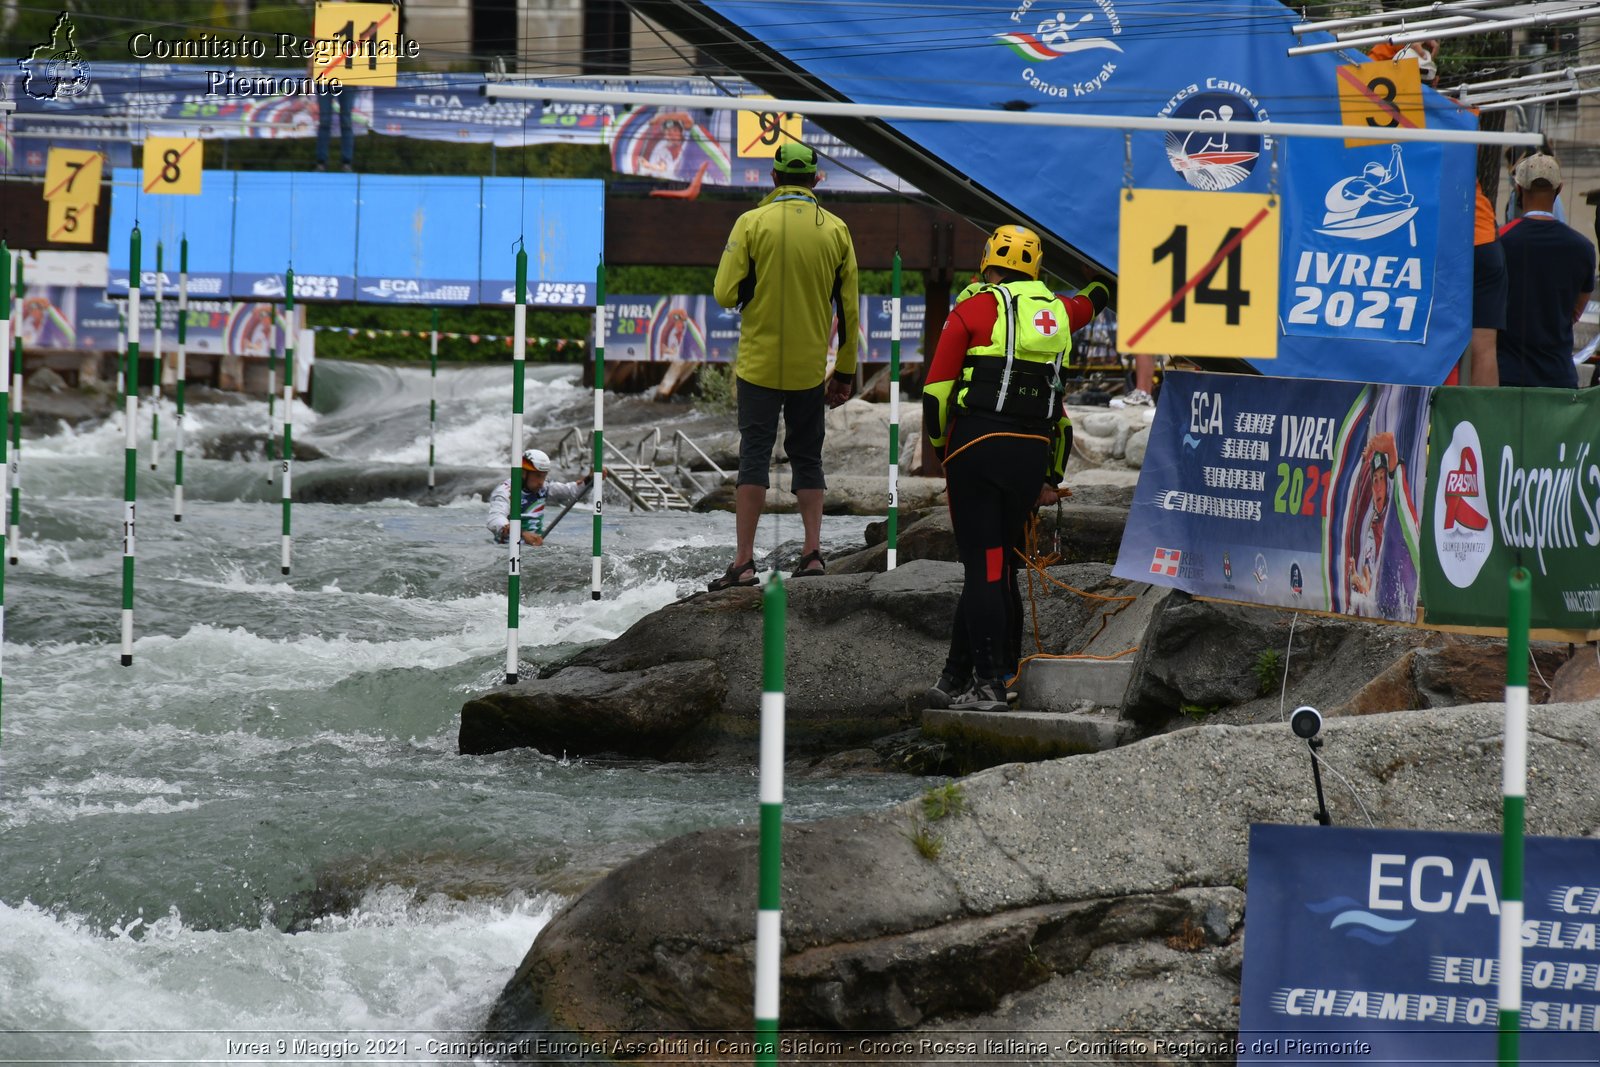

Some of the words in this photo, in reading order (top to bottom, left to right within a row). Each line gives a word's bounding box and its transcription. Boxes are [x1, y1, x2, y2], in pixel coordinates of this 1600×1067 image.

[336, 20, 380, 71] 11
[1021, 66, 1069, 98] Canoa
[1073, 60, 1117, 97] Kayak
[1206, 77, 1260, 108] Canoa
[1366, 77, 1401, 128] 3
[759, 111, 781, 145] 9
[65, 162, 82, 193] 7
[162, 149, 181, 183] 8
[64, 207, 78, 232] 5
[140, 272, 170, 285] CA
[380, 281, 419, 292] ECA
[1152, 225, 1250, 326] 14
[1295, 251, 1422, 290] IVREA
[535, 294, 586, 304] 2021
[538, 284, 586, 294] IVREA
[618, 304, 653, 318] IVREA
[1288, 286, 1418, 331] 2021
[617, 318, 653, 334] 2021
[1190, 391, 1224, 435] ECA
[1234, 412, 1277, 435] CANOE
[1220, 437, 1270, 461] SLALOM
[1279, 415, 1336, 460] IVREA
[1203, 466, 1266, 491] EUROPEAN
[1274, 462, 1332, 518] 2021
[596, 501, 602, 513] 9
[1155, 489, 1262, 522] CHAMPIONSHIPS
[1498, 443, 1584, 576] Raspini
[1369, 854, 1500, 916] ECA
[1430, 956, 1600, 991] EUOP
